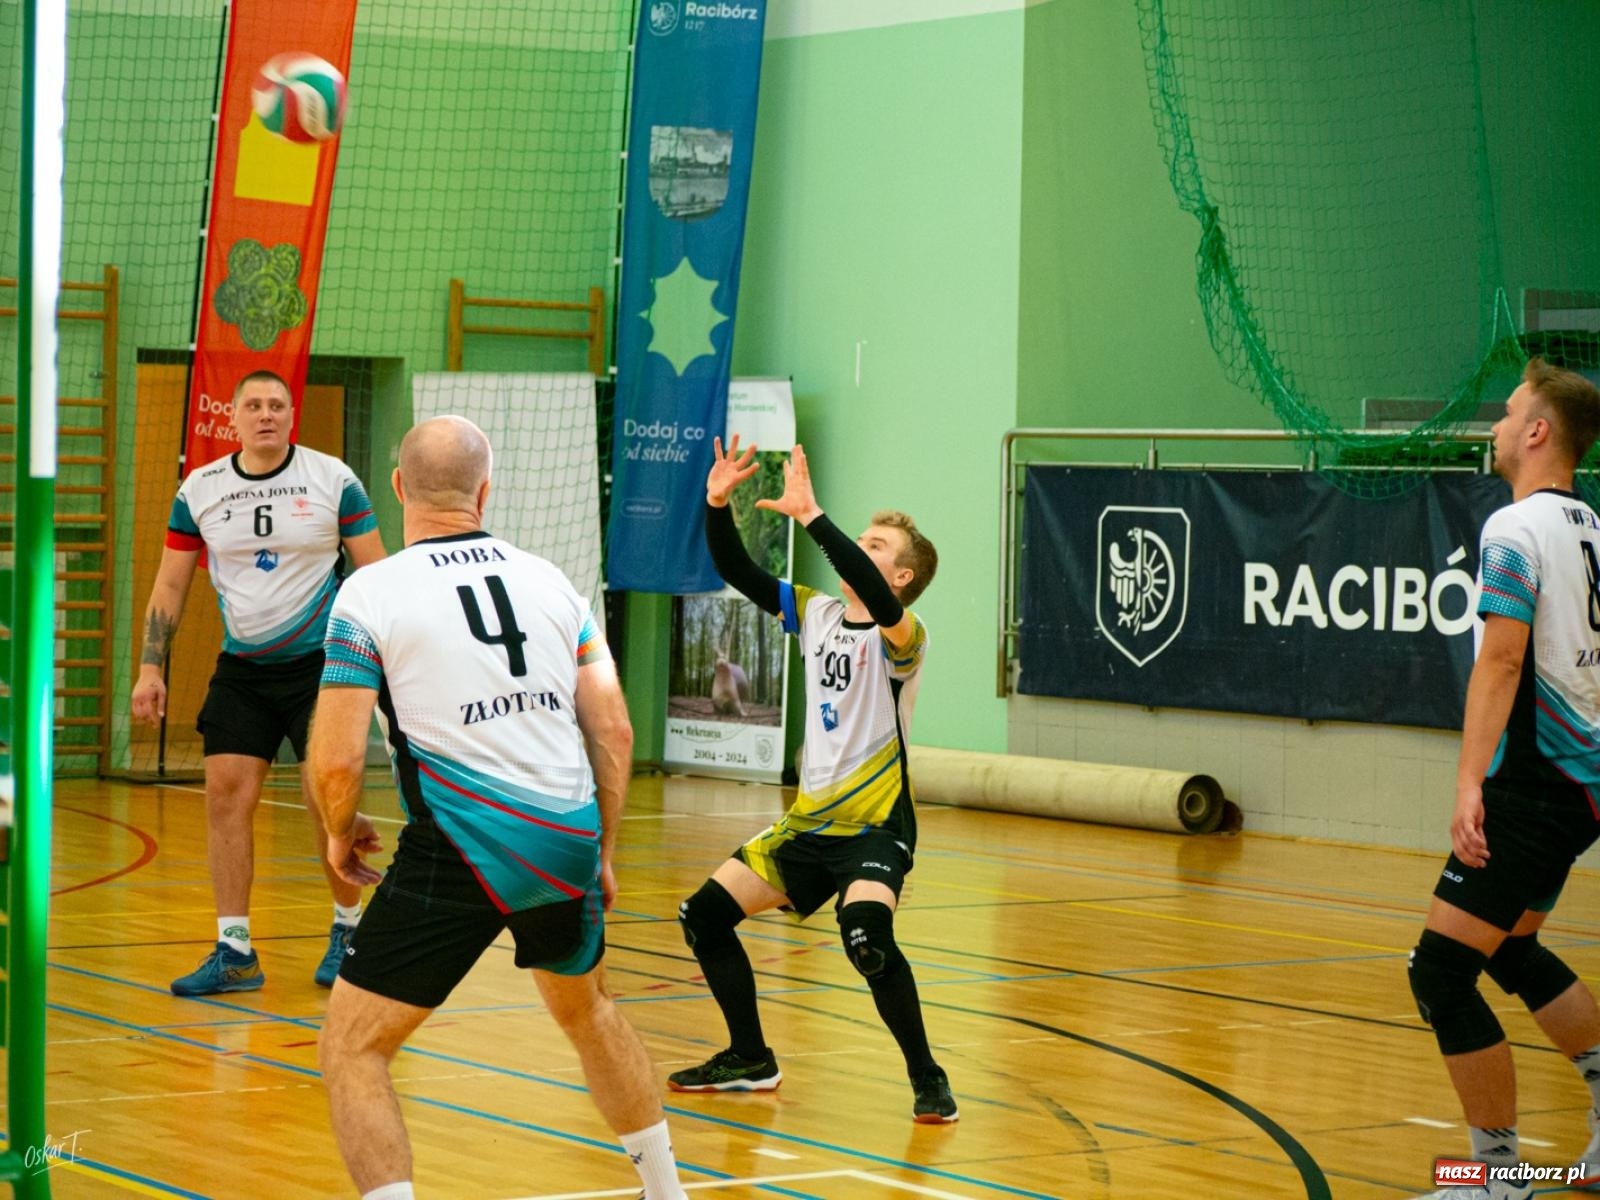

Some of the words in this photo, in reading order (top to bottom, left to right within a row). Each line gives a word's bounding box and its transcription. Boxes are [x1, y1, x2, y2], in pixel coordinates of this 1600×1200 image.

[684, 2, 758, 20] Racibórz
[624, 419, 678, 442] Dodaj
[683, 426, 705, 440] co
[642, 444, 689, 463] siebie
[267, 486, 308, 499] JOVEM
[254, 504, 272, 537] 6
[429, 546, 507, 568] DOBA
[1243, 545, 1478, 636] RACIBÓ
[456, 575, 527, 677] 4
[821, 651, 851, 691] 99
[694, 748, 716, 761] 2004
